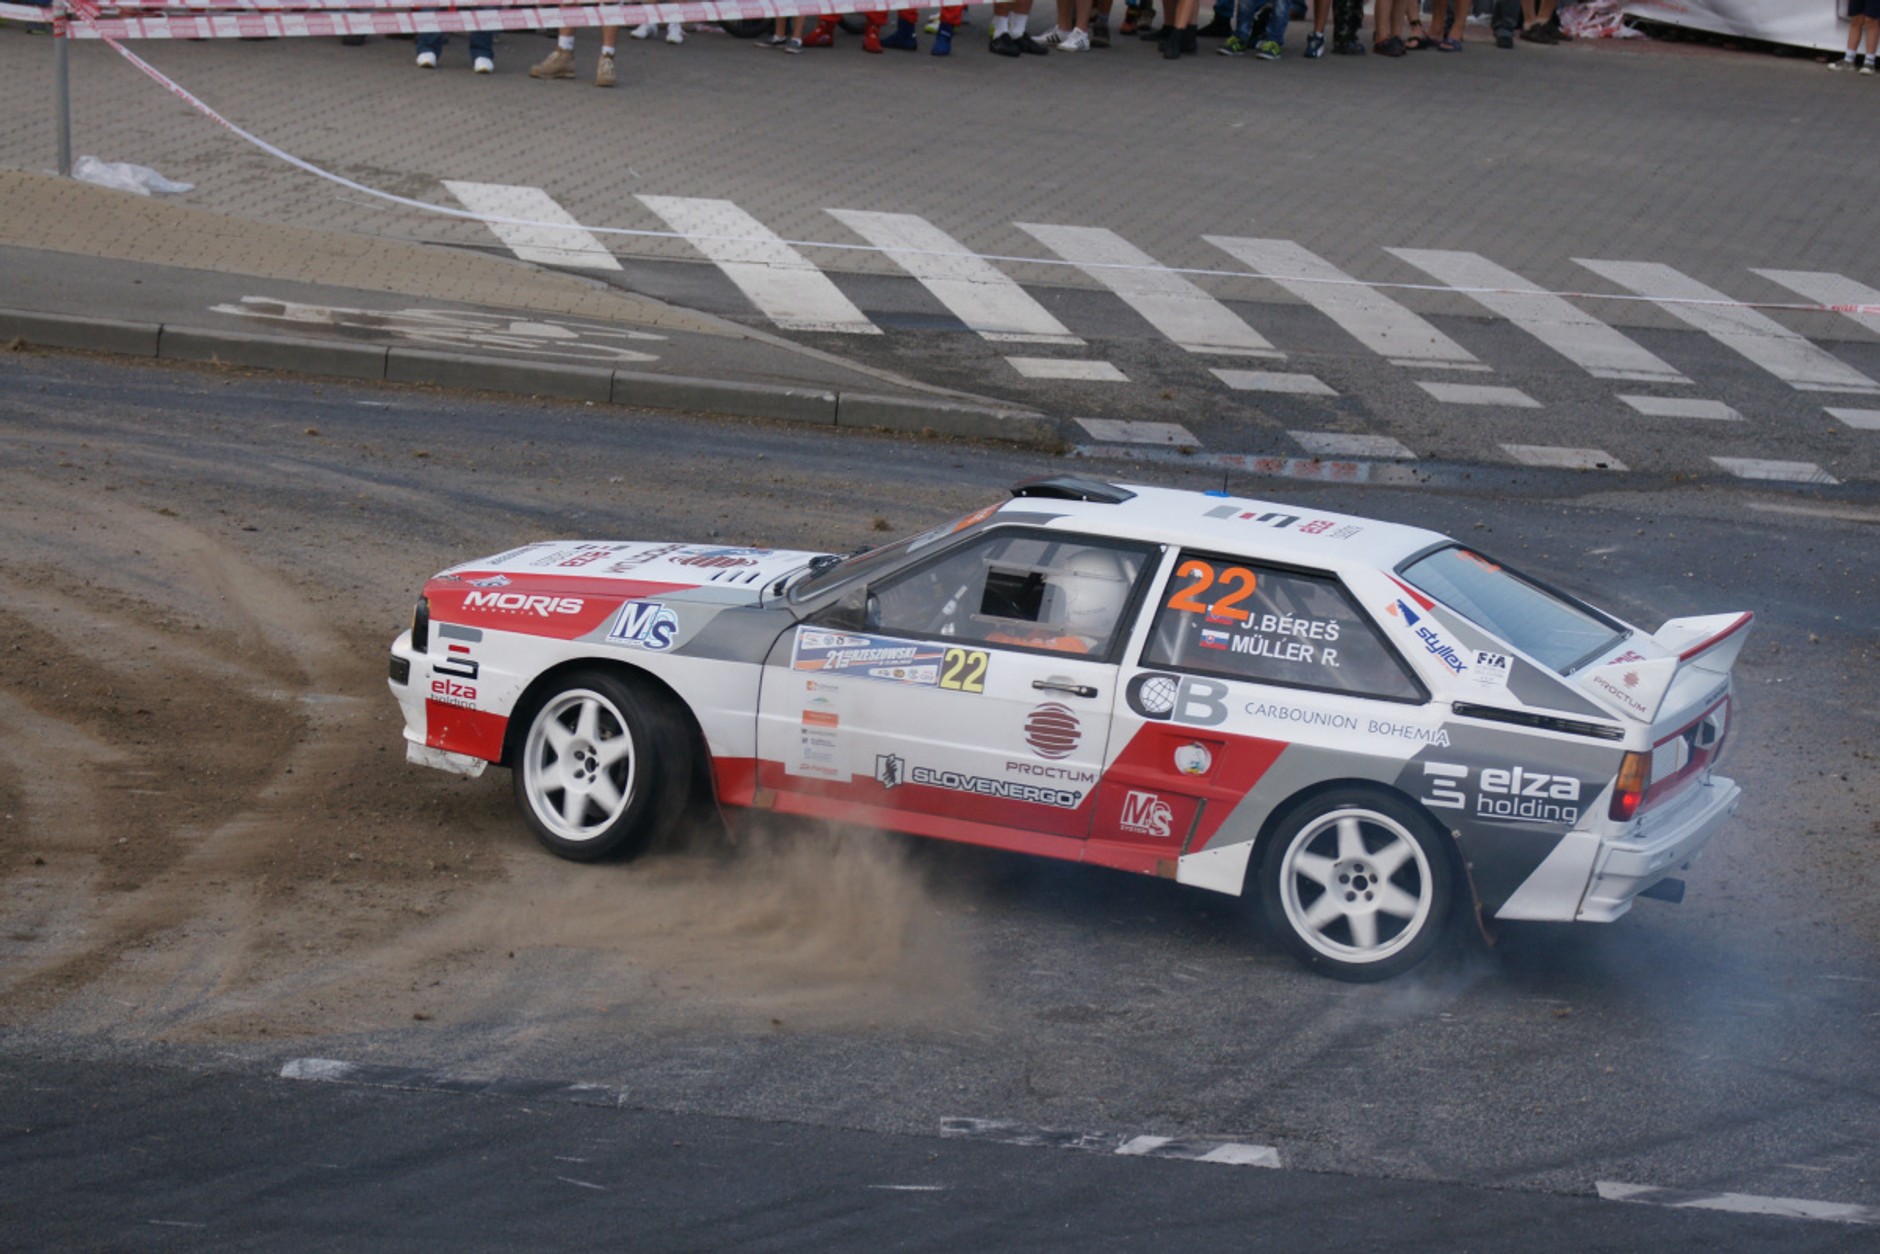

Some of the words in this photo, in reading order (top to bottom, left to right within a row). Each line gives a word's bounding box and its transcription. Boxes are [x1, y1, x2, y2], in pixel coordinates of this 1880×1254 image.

[463, 591, 585, 617] MORIS
[1167, 559, 1257, 621] 22
[1240, 612, 1340, 642] J.BÉREŠ
[823, 649, 845, 669] 21
[939, 648, 989, 693] 22
[1320, 647, 1340, 668] R.
[431, 678, 477, 700] elza
[1593, 675, 1647, 714] PROCTUM
[1244, 701, 1359, 730] CARBOUNION
[1367, 719, 1450, 746] BOHEMIA
[911, 766, 1076, 807] SLOVENERGO
[1005, 761, 1095, 784] PROCTUM
[1480, 766, 1581, 801] elza
[1477, 793, 1579, 825] holding
